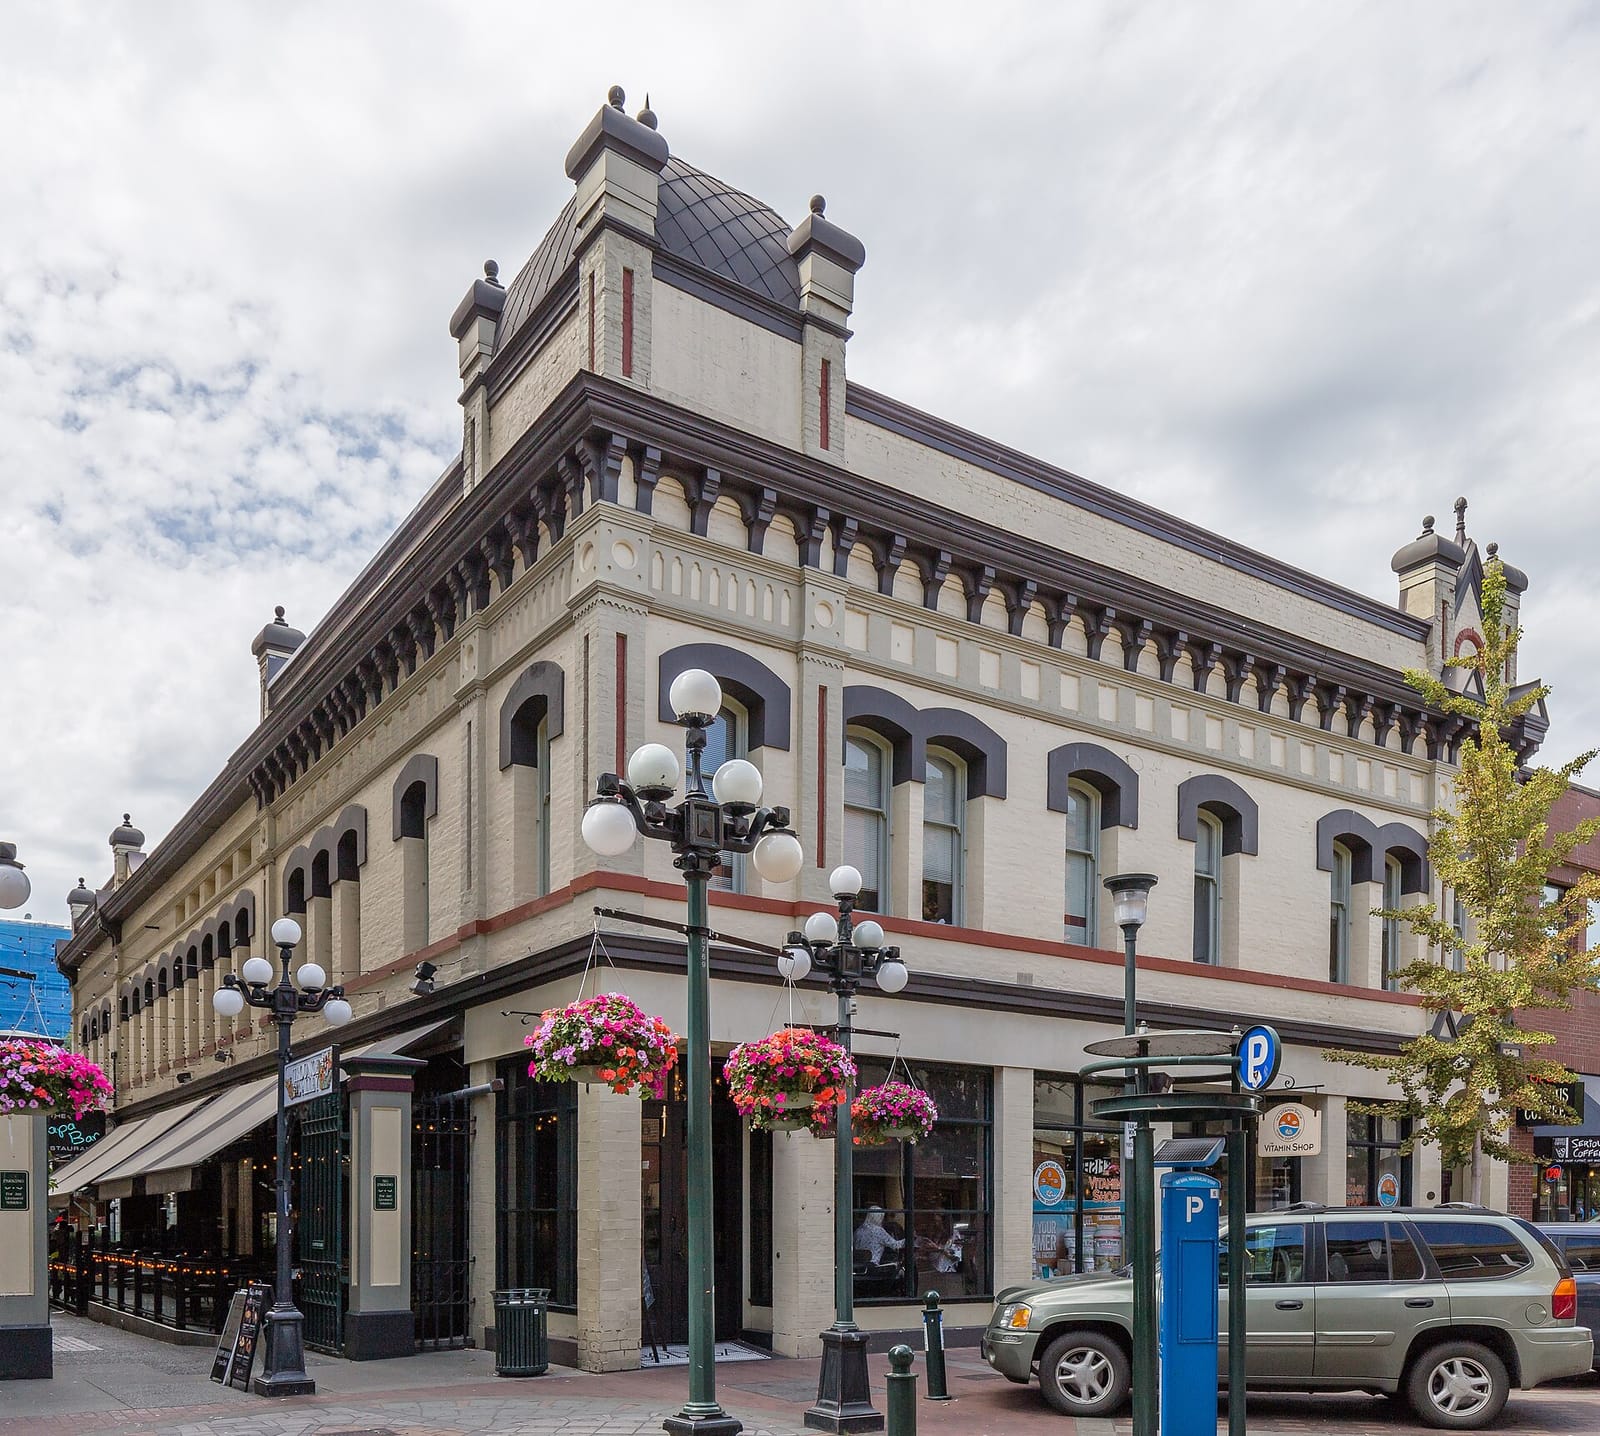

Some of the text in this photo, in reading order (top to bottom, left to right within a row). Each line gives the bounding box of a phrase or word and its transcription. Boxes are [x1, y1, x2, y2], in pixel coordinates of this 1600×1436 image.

[1248, 1035, 1268, 1083] P
[68, 1131, 100, 1145] Bar
[1264, 1143, 1314, 1152] VITAMIN SHOP
[1092, 1189, 1120, 1202] SHOP
[1186, 1196, 1204, 1222] P
[1038, 1220, 1057, 1234] YOUR
